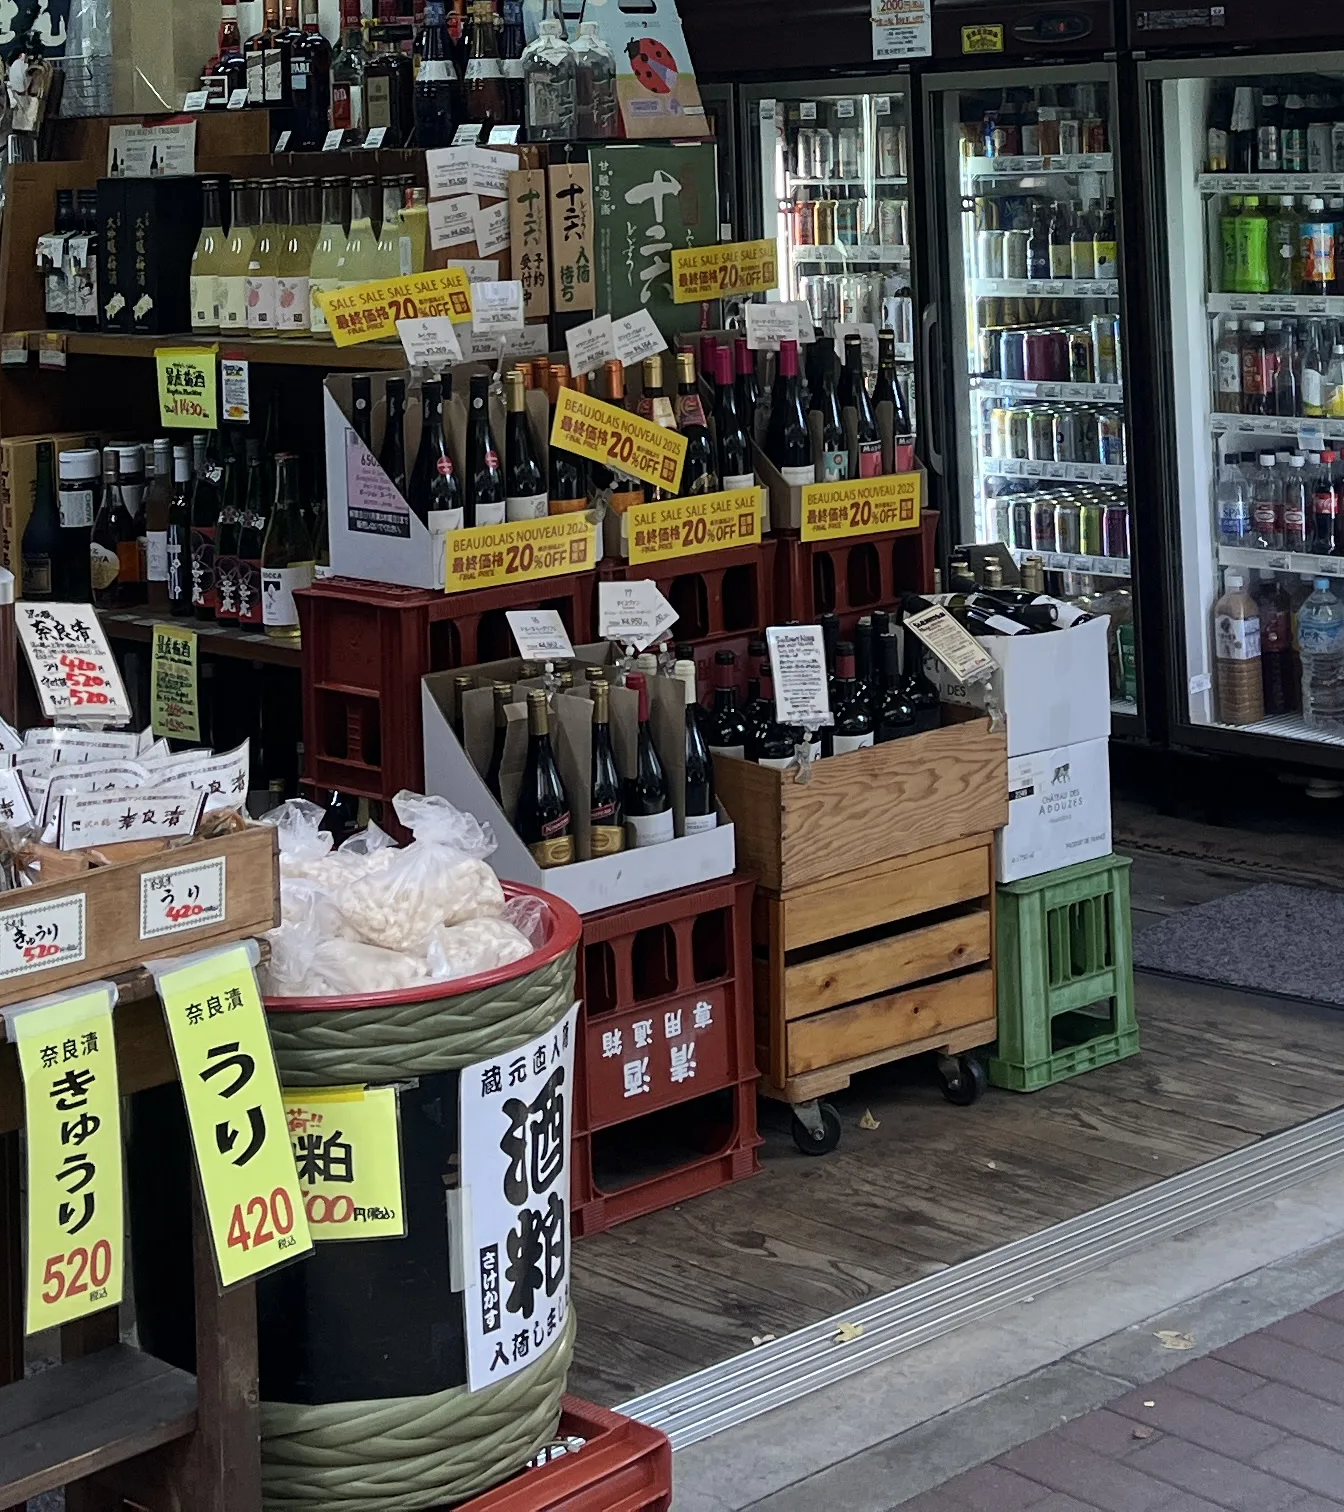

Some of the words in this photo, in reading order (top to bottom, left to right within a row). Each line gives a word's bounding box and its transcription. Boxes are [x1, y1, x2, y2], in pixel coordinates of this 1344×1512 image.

[575, 246, 591, 284] 入荷
[678, 256, 697, 268] SALE
[700, 253, 718, 265] SALE
[721, 250, 740, 262] SALE
[741, 248, 758, 260] SALE
[758, 246, 775, 258] SALE
[559, 264, 575, 303] 待ち
[678, 271, 718, 288] 最終価格
[329, 295, 357, 312] SALE
[358, 289, 386, 305] SALE
[387, 283, 413, 299] SALE
[413, 279, 440, 295] SALE
[441, 275, 463, 289] SALE
[335, 306, 390, 330] 最終価格
[560, 415, 609, 446] 最終価格
[564, 398, 621, 430] BEAUJOLAIS
[620, 420, 663, 447] NOUVEAU
[662, 437, 681, 456] 2025
[807, 491, 857, 506] BEAUJOLAIS
[858, 484, 895, 501] NOUVEAU
[896, 482, 916, 494] 2025
[634, 511, 657, 527] SALE
[660, 506, 683, 522] SALE
[685, 502, 709, 518] SALE
[710, 498, 733, 514] SALE
[735, 495, 756, 510] SALE
[807, 507, 849, 525] 最終価格
[453, 531, 515, 553] BEAUJOLAIS
[516, 525, 565, 542] NOUVEAU
[634, 525, 681, 549] 最終価格
[451, 551, 504, 575] 最終価格
[946, 683, 967, 698] DES
[119, 805, 187, 831] 奈良漬
[1038, 796, 1084, 817] ADOUZES
[159, 886, 201, 905] うり
[165, 904, 204, 922] 420
[14, 923, 60, 950] きゅうり
[23, 943, 61, 963] 520
[184, 987, 245, 1027] 奈良漬
[39, 1030, 100, 1070] 奈良漬
[623, 1041, 697, 1099] 清酒
[198, 1040, 267, 1168] うり
[48, 1068, 102, 1236] きゅうり
[500, 1065, 567, 1320] 酒粕
[226, 1186, 295, 1253] 420
[277, 1234, 297, 1251] 税込
[41, 1239, 112, 1305] 520
[89, 1287, 109, 1304] 税込
[483, 1250, 500, 1329] さけかす
